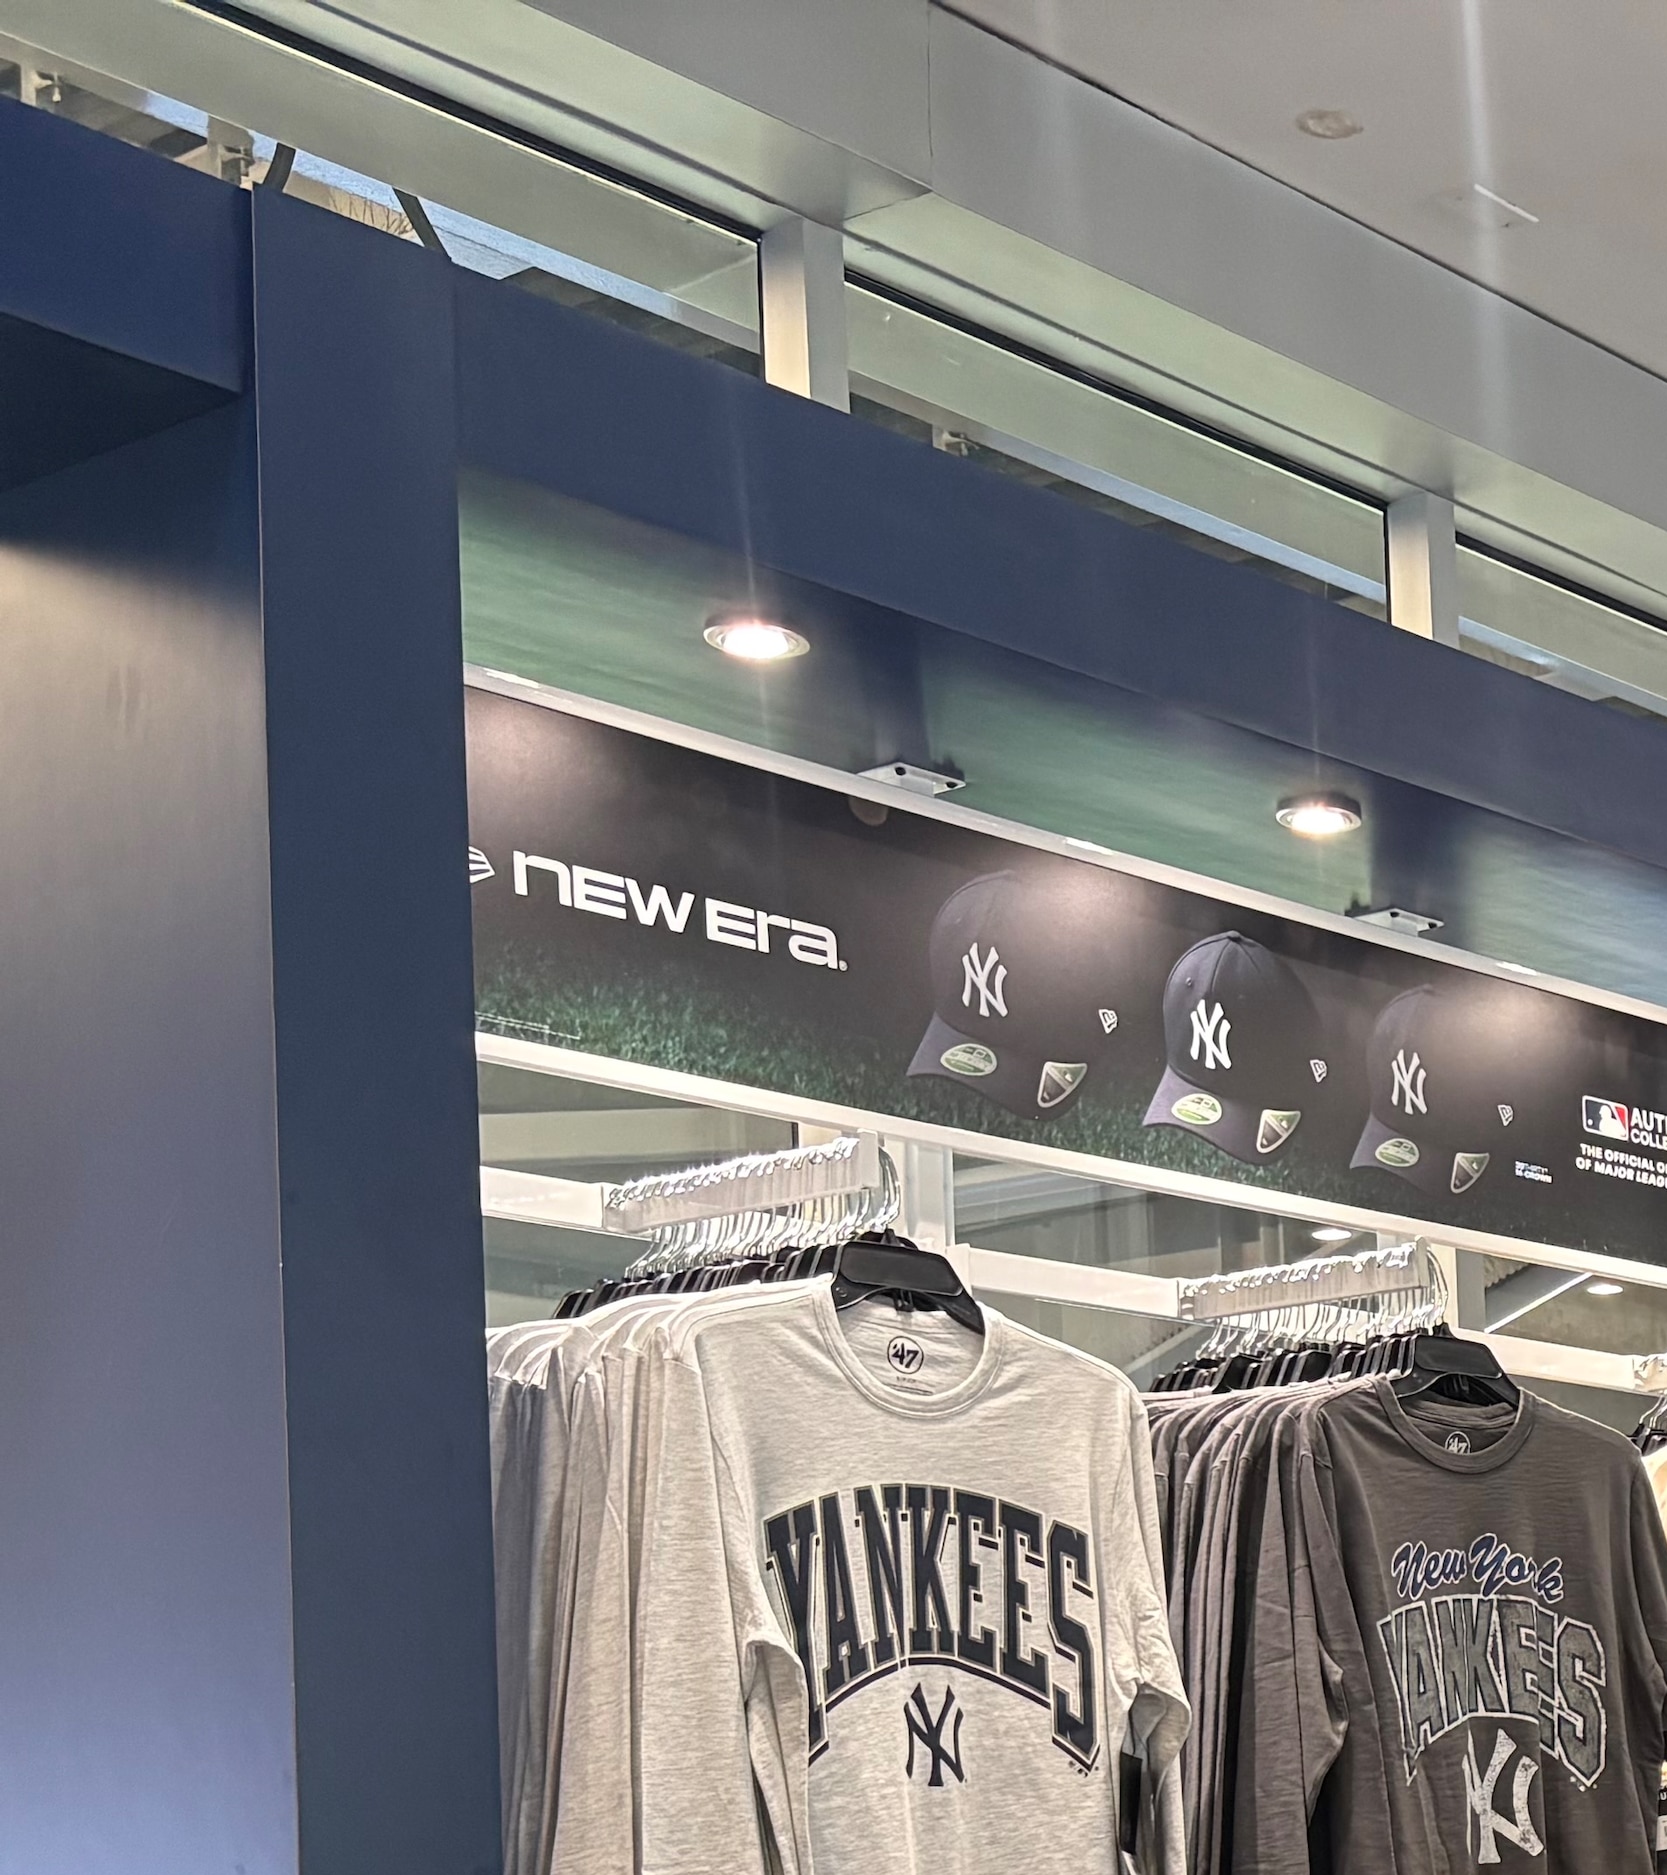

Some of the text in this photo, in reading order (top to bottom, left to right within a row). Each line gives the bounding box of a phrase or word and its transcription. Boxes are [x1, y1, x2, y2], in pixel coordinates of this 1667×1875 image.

[1575, 1156, 1592, 1170] OF
[1593, 1161, 1635, 1182] MAJOR
[1580, 1143, 1603, 1159] THE
[1604, 1147, 1655, 1173] OFFICIAL
[1392, 1533, 1564, 1603] New York
[764, 1482, 1102, 1772] YANKEES
